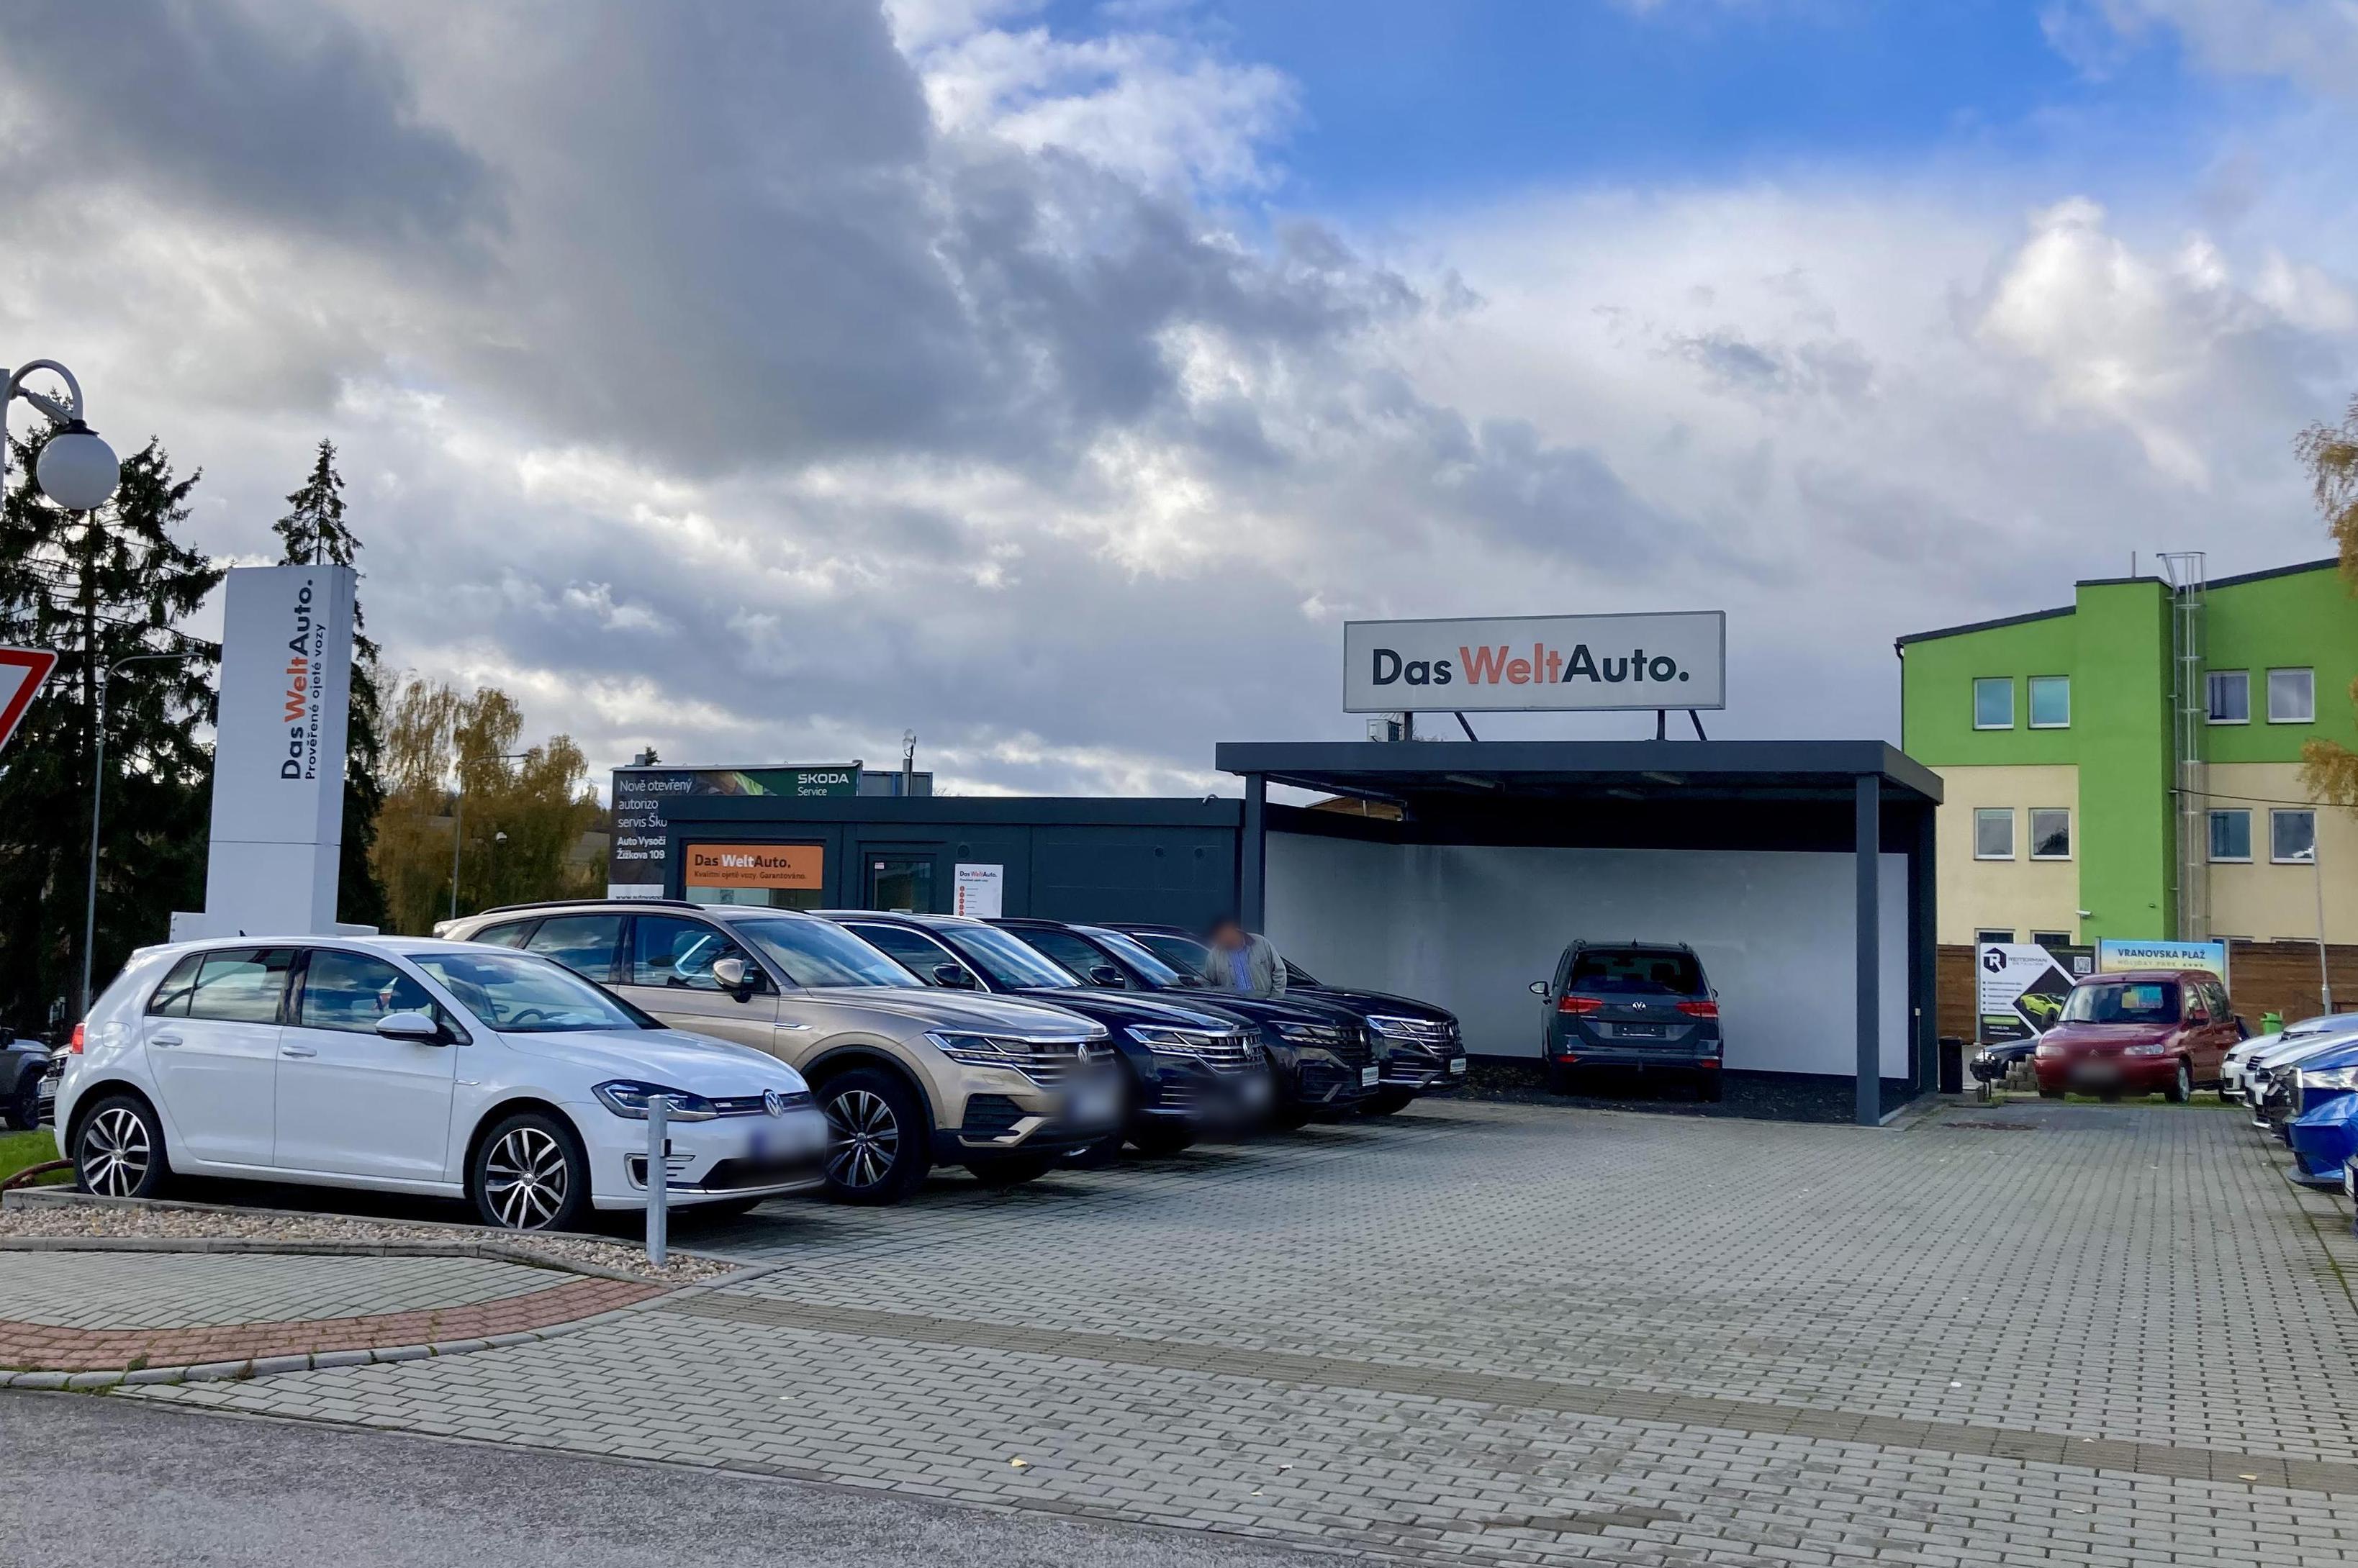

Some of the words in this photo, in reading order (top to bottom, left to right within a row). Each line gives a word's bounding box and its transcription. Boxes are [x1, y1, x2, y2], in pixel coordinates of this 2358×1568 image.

[284, 579, 314, 722] WeltAuto.
[315, 624, 326, 657] vozy
[310, 661, 323, 699] ojeté
[1372, 648, 1453, 686] Das
[1459, 643, 1690, 685] WeltAuto.
[281, 726, 304, 779] Das
[305, 704, 320, 779] Prověřené
[620, 779, 646, 792] Nově
[648, 778, 692, 794] otevřený
[798, 786, 828, 797] Service
[618, 816, 646, 828] servis
[617, 836, 637, 846] Auto
[695, 854, 718, 866] Das
[721, 853, 791, 868] WeltAuto.
